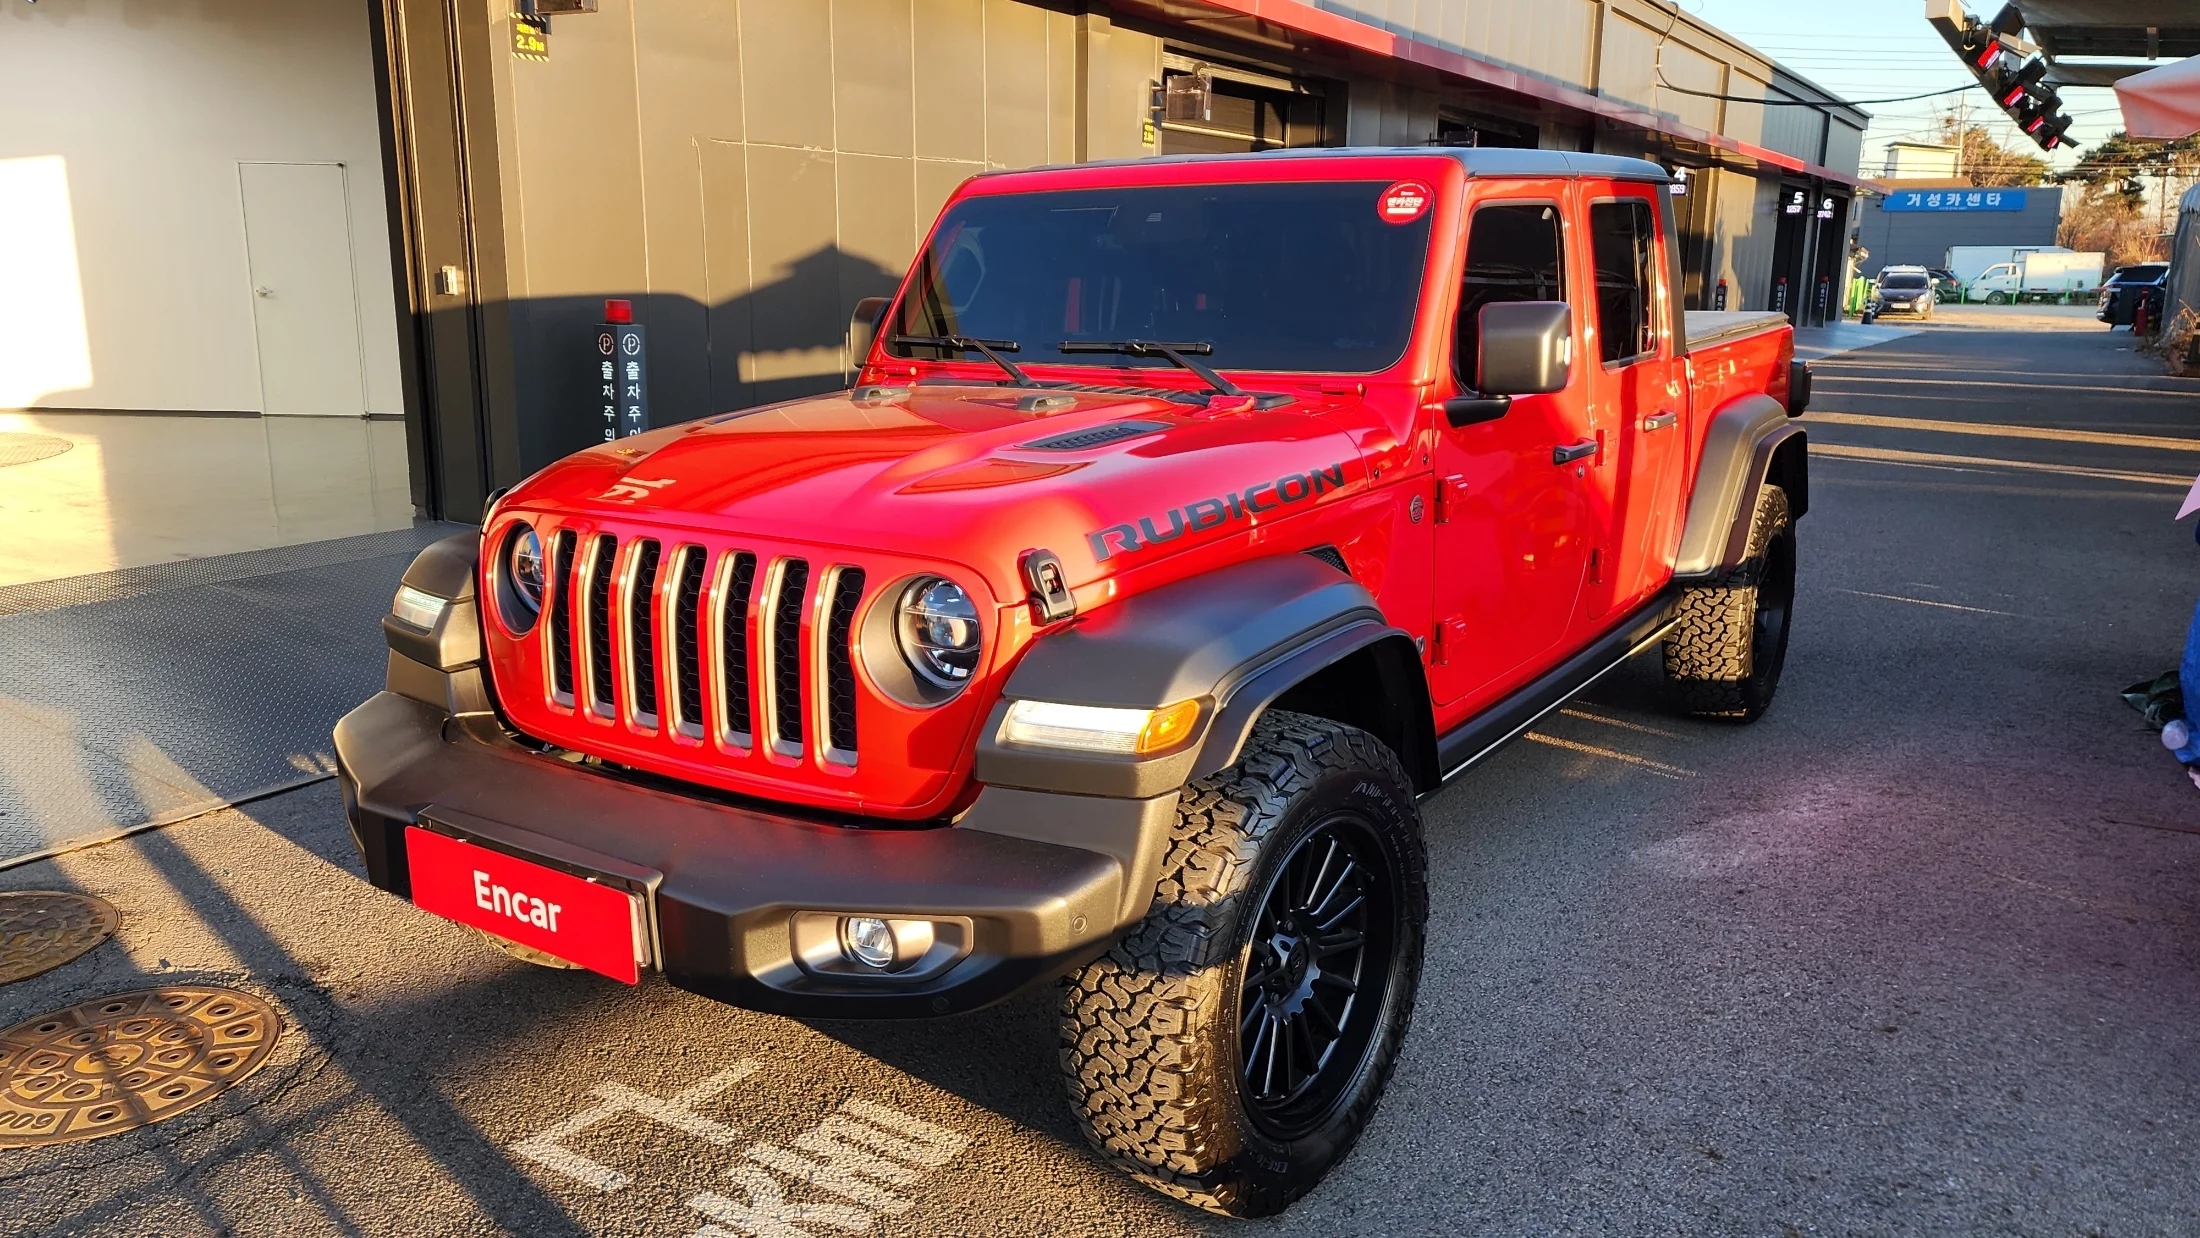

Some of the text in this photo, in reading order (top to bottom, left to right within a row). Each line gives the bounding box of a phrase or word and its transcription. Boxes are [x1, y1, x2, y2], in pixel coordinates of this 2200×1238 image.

[1674, 166, 1687, 181] 4
[1793, 191, 1804, 204] 5
[1823, 198, 1833, 209] 6
[1906, 193, 2001, 207] 거성카센타
[601, 360, 616, 441] 출차주의
[1087, 463, 1345, 561] RUBICON
[473, 869, 562, 933] Encar
